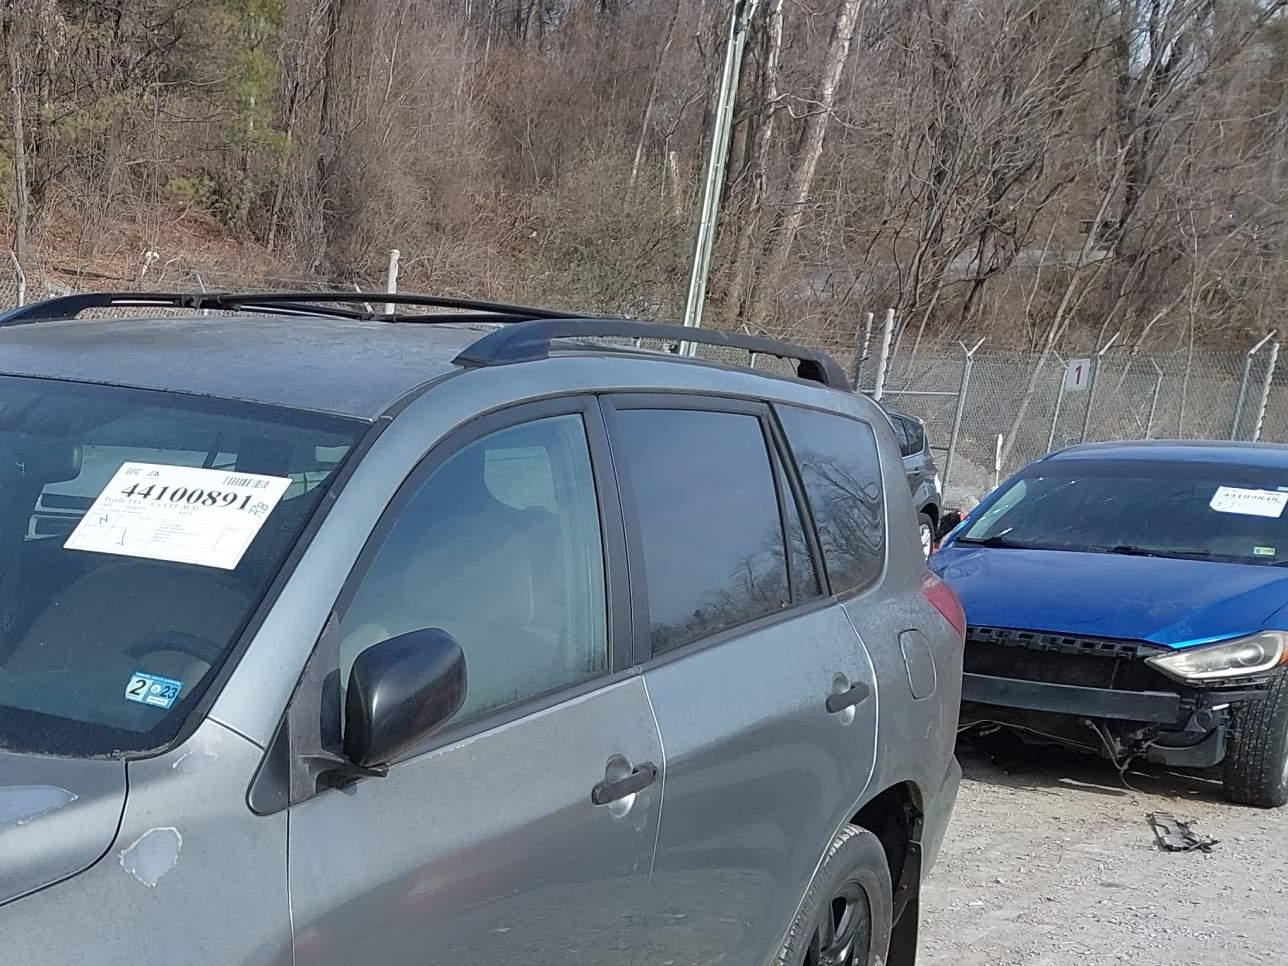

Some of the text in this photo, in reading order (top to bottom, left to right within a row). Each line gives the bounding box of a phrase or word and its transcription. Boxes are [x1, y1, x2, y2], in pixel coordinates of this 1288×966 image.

[1075, 365, 1082, 385] 1
[121, 482, 253, 511] 44100891
[129, 679, 146, 696] 2
[160, 686, 178, 699] 23
